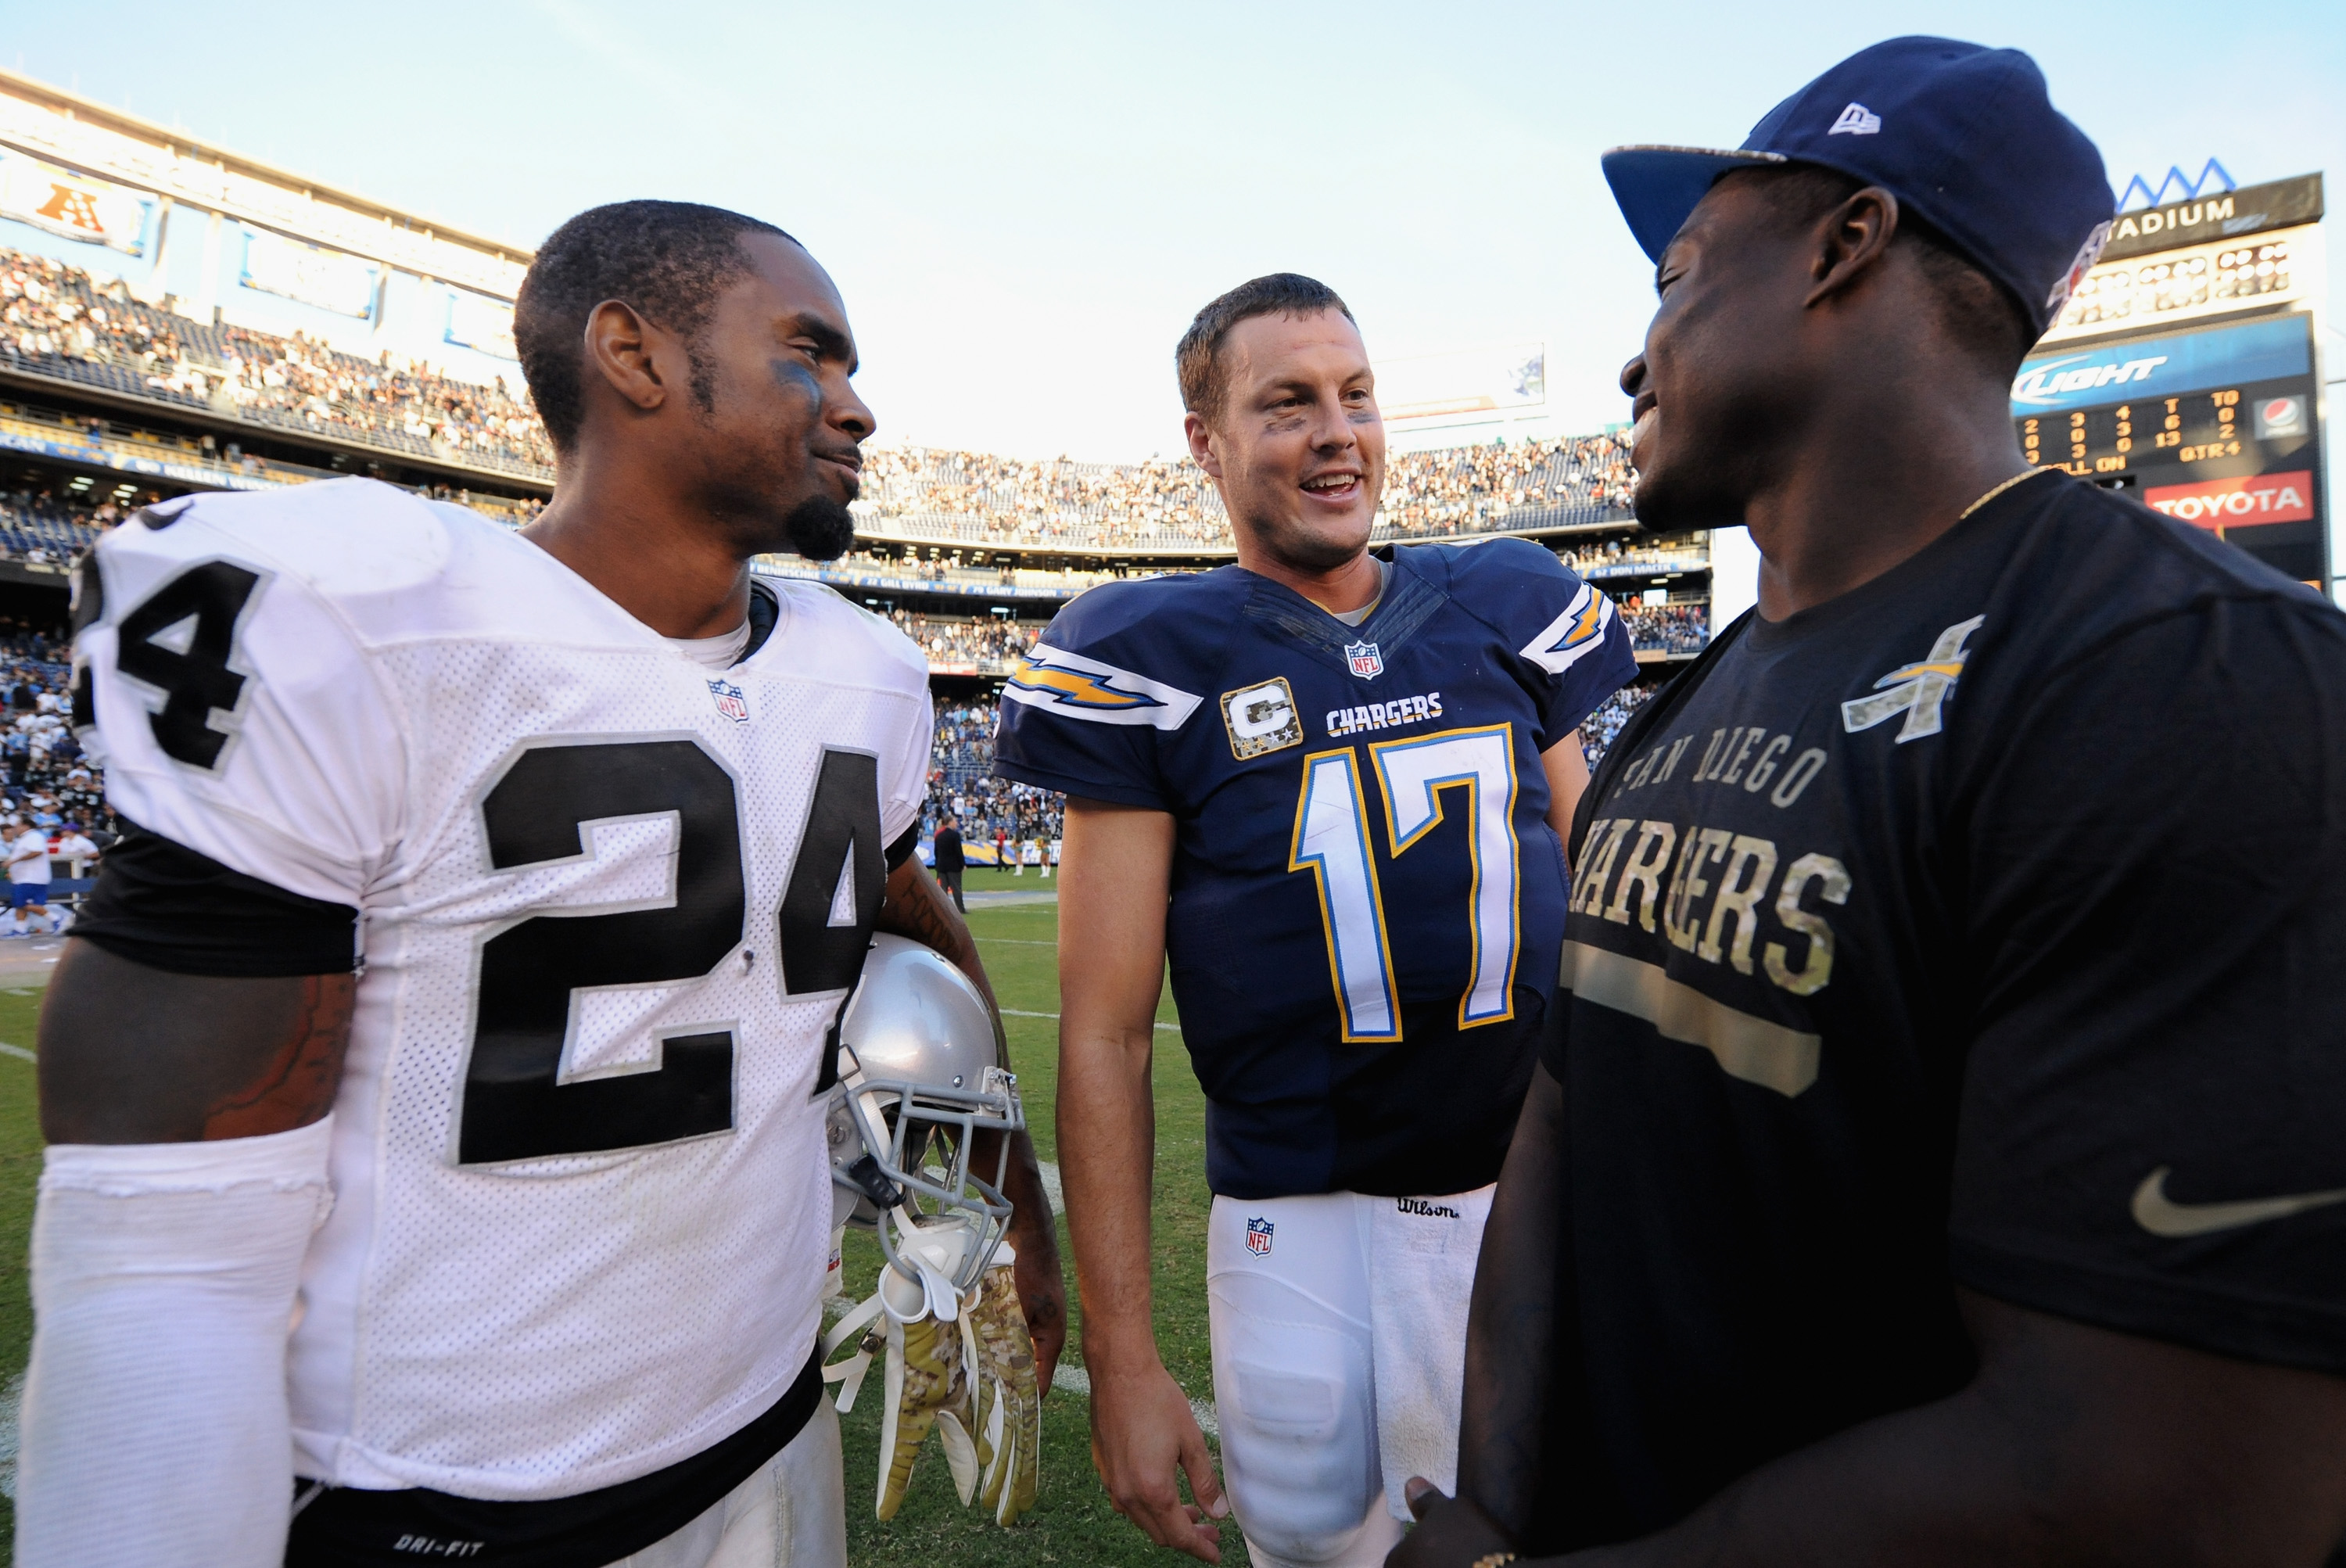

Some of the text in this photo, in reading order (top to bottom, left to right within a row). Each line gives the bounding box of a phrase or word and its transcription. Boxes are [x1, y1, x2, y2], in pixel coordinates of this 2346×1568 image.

[2106, 197, 2234, 242] TADIUM
[2025, 419, 2039, 434] 2
[2070, 412, 2085, 427] 3
[2115, 405, 2131, 420] 4
[2165, 398, 2179, 414] T
[2025, 407, 2234, 449] 0 0 3 6 0
[2072, 443, 2086, 458] 3
[2117, 437, 2132, 452] 0
[2155, 430, 2180, 447] 13
[2219, 424, 2235, 439] 2
[2153, 486, 2304, 519] TOYOTA
[881, 578, 900, 588] GILL
[902, 580, 929, 590] BYRD
[1610, 565, 1632, 577] DON
[986, 587, 1012, 596] GARY
[1013, 587, 1056, 597] JOHNSON
[1353, 658, 1378, 673] NFL
[718, 696, 746, 718] NFL
[1229, 685, 1290, 739] C
[1326, 692, 1443, 737] CHARGERS
[1692, 727, 1828, 809] DIEGO
[1288, 722, 1520, 1042] 17
[452, 730, 888, 1165] 24
[1397, 1197, 1456, 1218] Wilson
[1248, 1232, 1269, 1252] NFL
[393, 1534, 484, 1557] DRI-FIT
